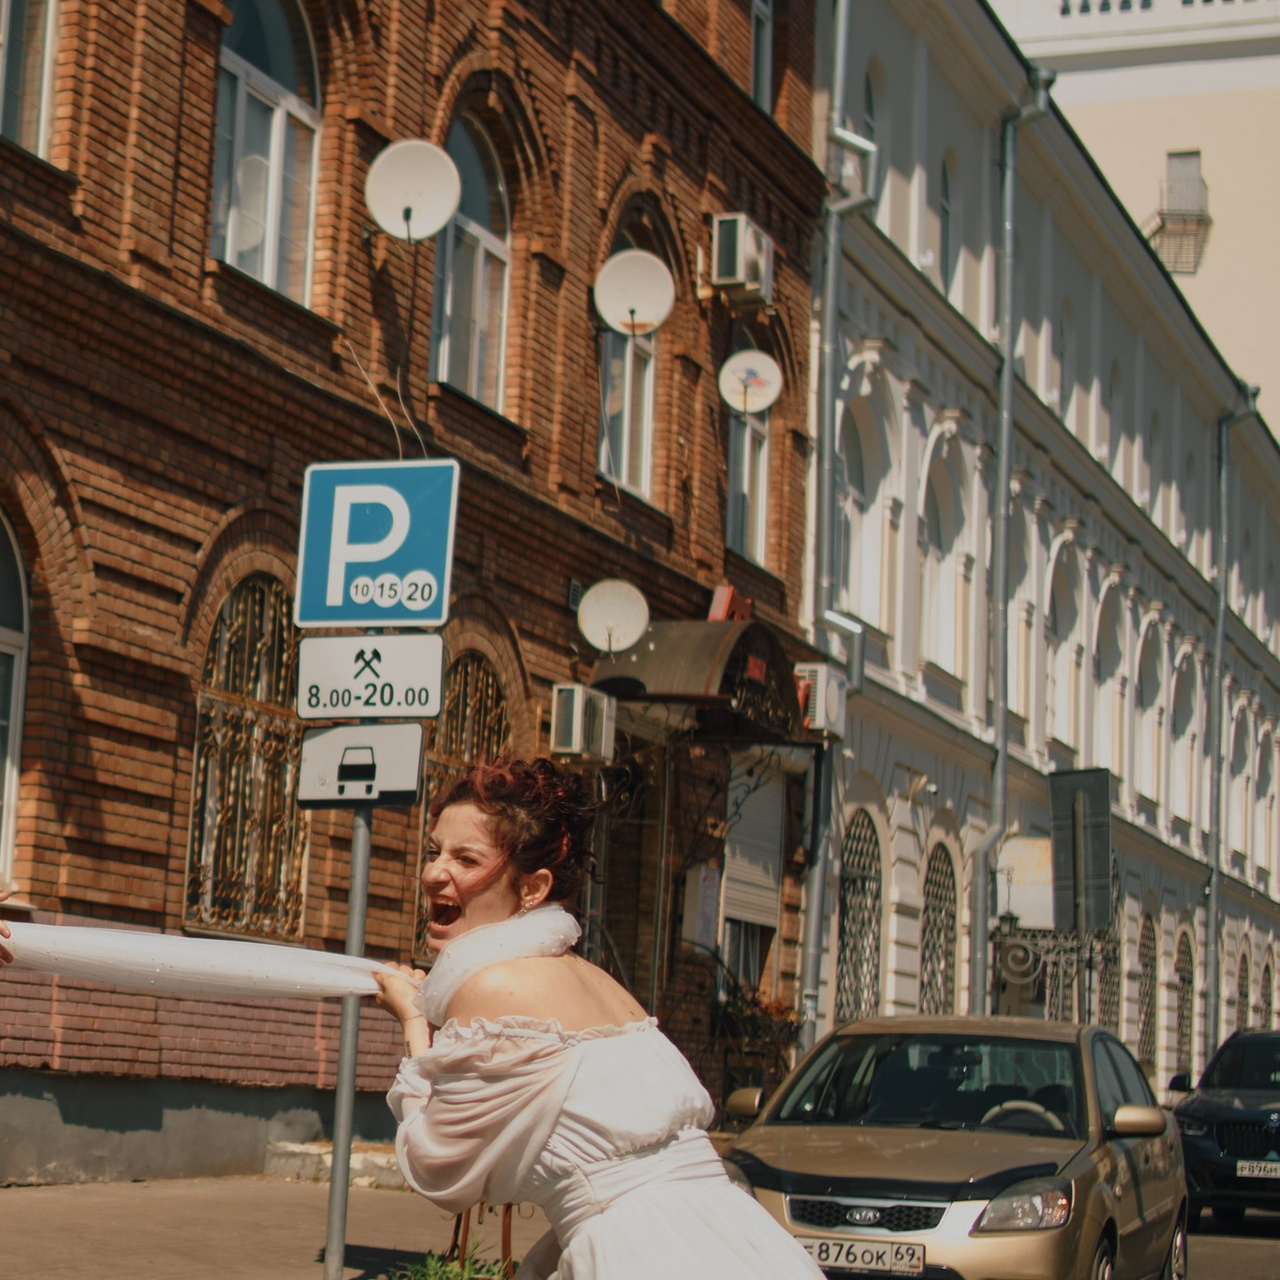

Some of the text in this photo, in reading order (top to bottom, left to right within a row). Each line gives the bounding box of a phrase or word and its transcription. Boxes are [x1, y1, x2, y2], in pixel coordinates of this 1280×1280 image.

[325, 484, 411, 607] P
[353, 582, 433, 602] 10 15 20
[307, 682, 430, 709] 8.00-20.00
[894, 1245, 916, 1262] 69
